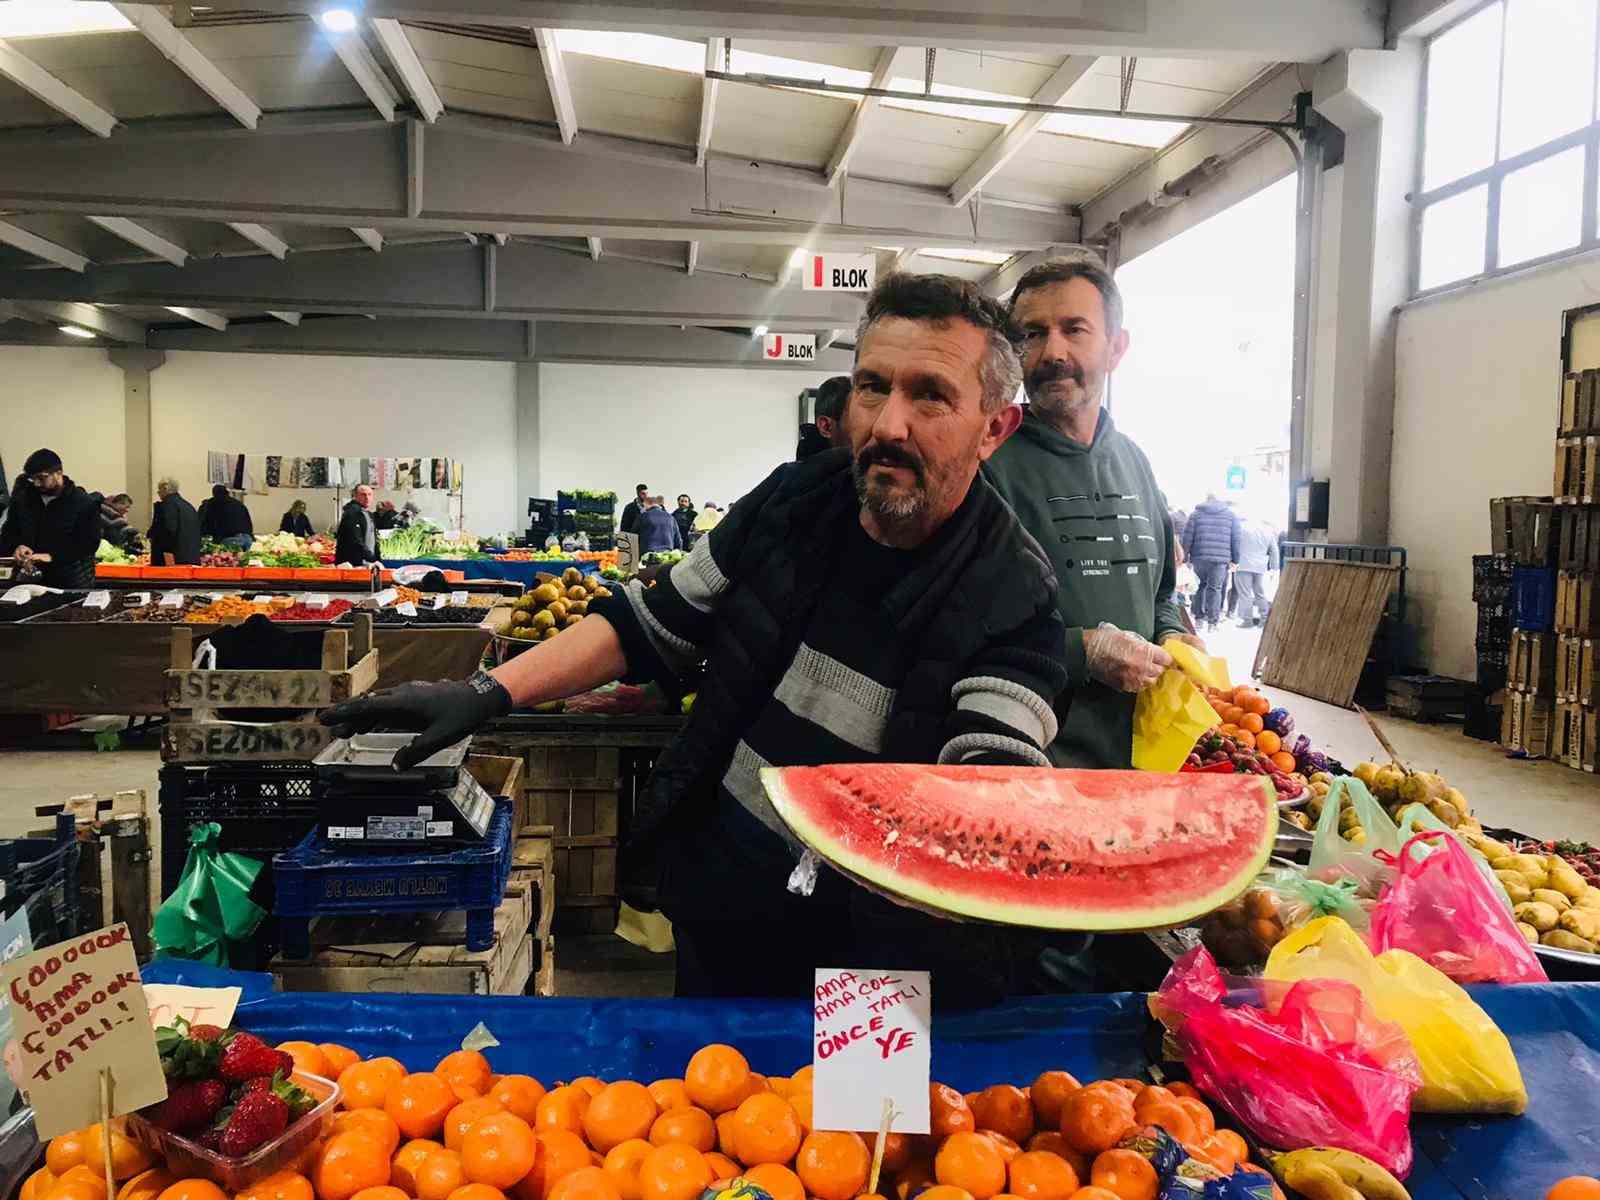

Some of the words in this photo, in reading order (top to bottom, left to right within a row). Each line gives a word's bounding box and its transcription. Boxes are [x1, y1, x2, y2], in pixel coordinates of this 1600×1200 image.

[814, 255, 823, 288] I
[832, 269, 868, 288] BLOK
[767, 335, 782, 357] J
[788, 344, 813, 358] BLOK
[34, 972, 93, 1023] AMA
[815, 992, 855, 1021] AMA
[859, 976, 902, 1000] ÇOK
[816, 972, 858, 1000] AMA
[868, 985, 920, 1014] TATLI
[816, 1016, 884, 1060] ÖNCE
[875, 1027, 916, 1059] YE
